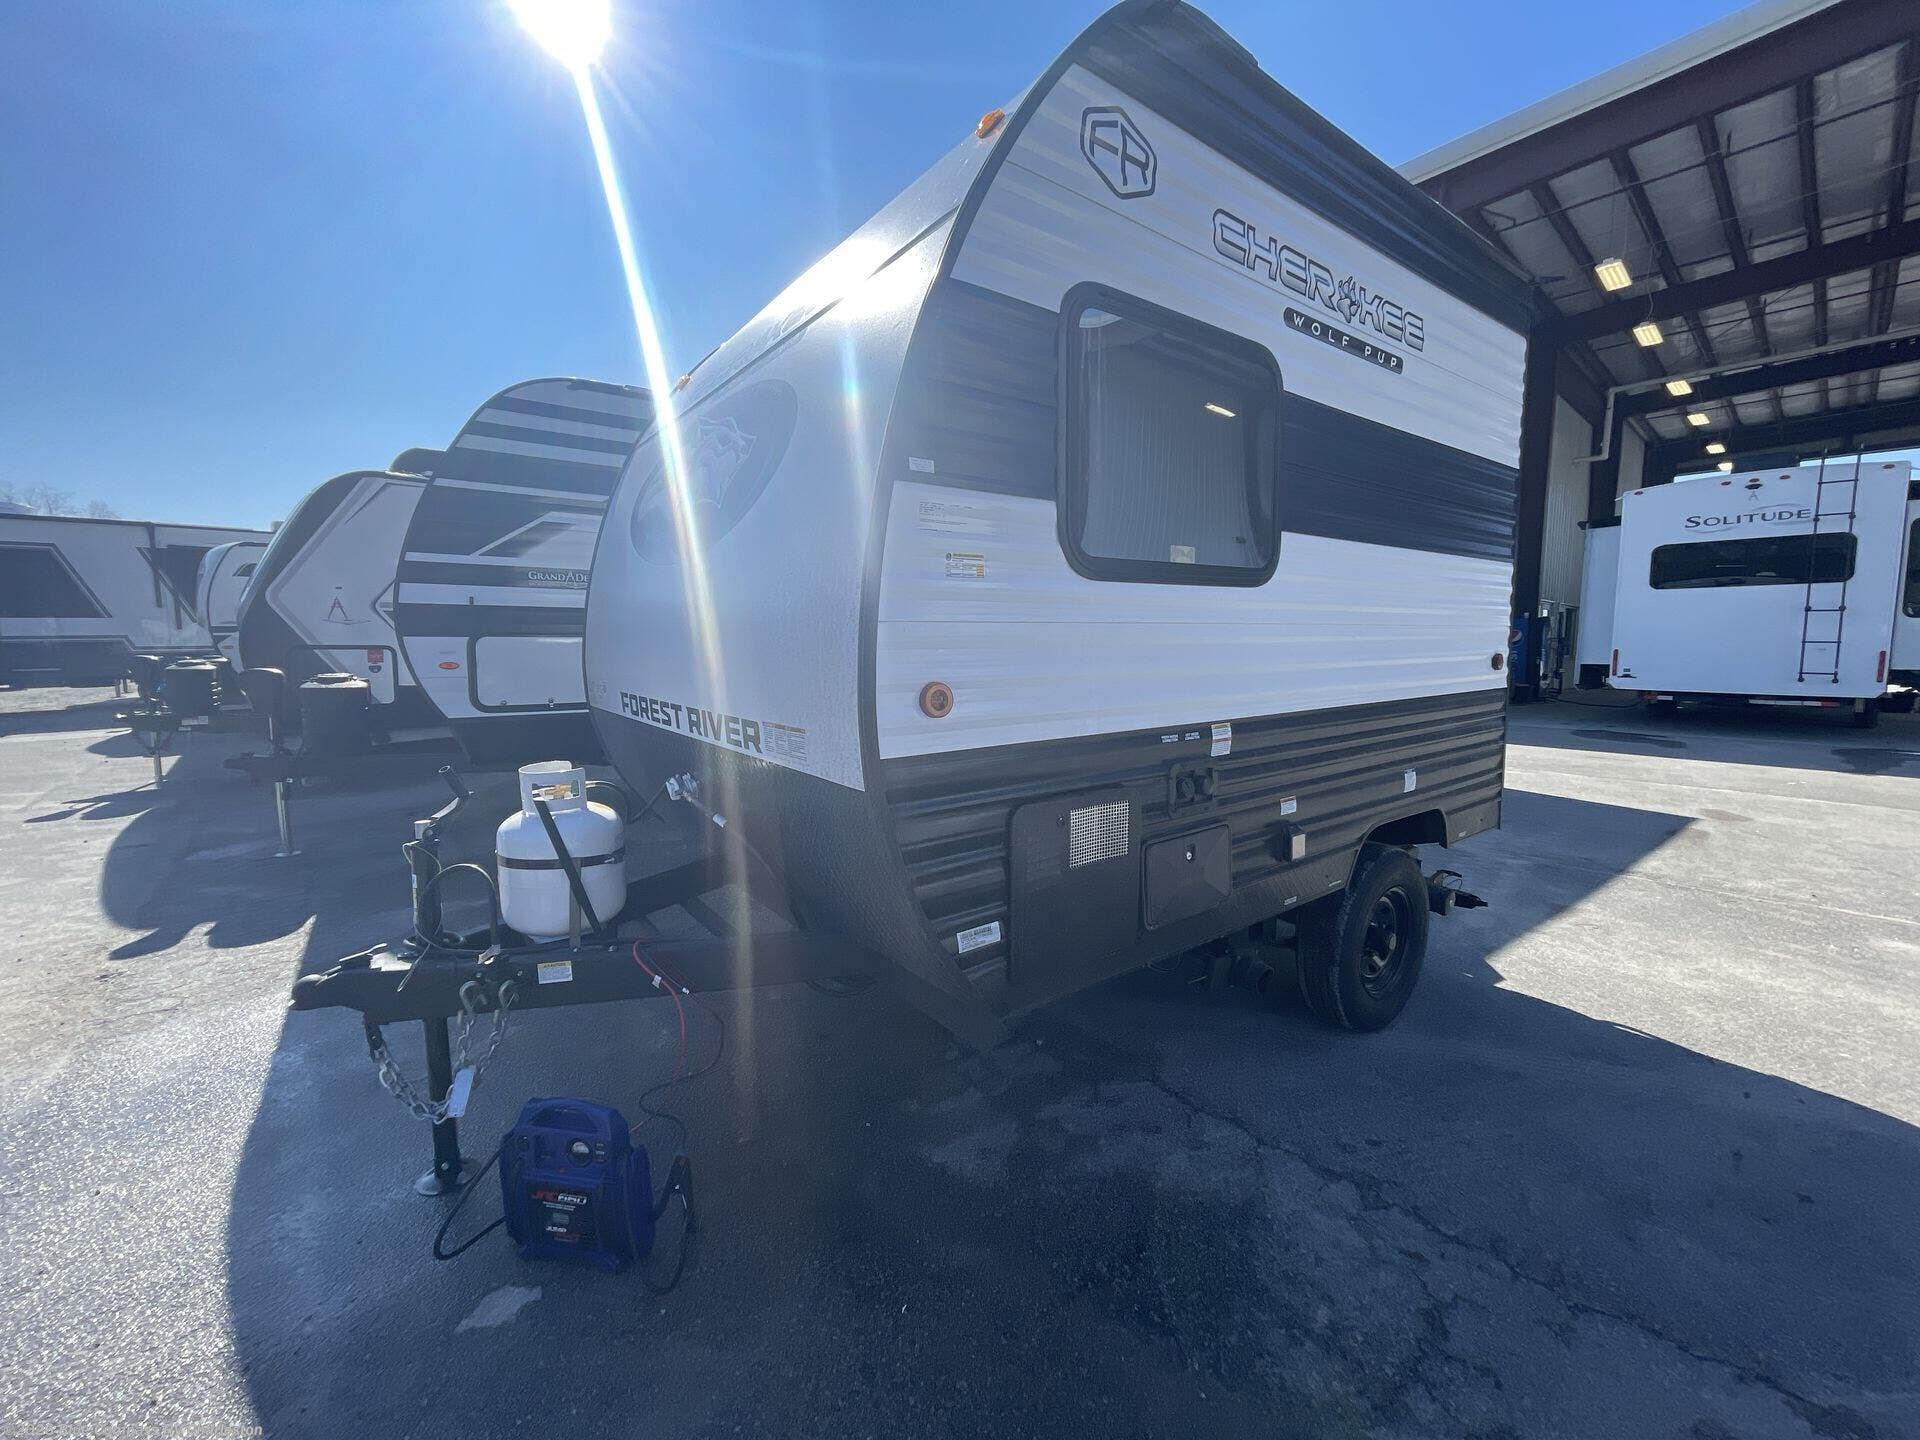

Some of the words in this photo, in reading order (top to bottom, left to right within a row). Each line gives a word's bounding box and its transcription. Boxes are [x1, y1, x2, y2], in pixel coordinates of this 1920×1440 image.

[1292, 312, 1352, 348] WOLF
[1363, 344, 1398, 369] PUP
[1684, 508, 1812, 529] SOLITUDE
[619, 690, 683, 730] FOREST
[685, 705, 763, 754] RIVER
